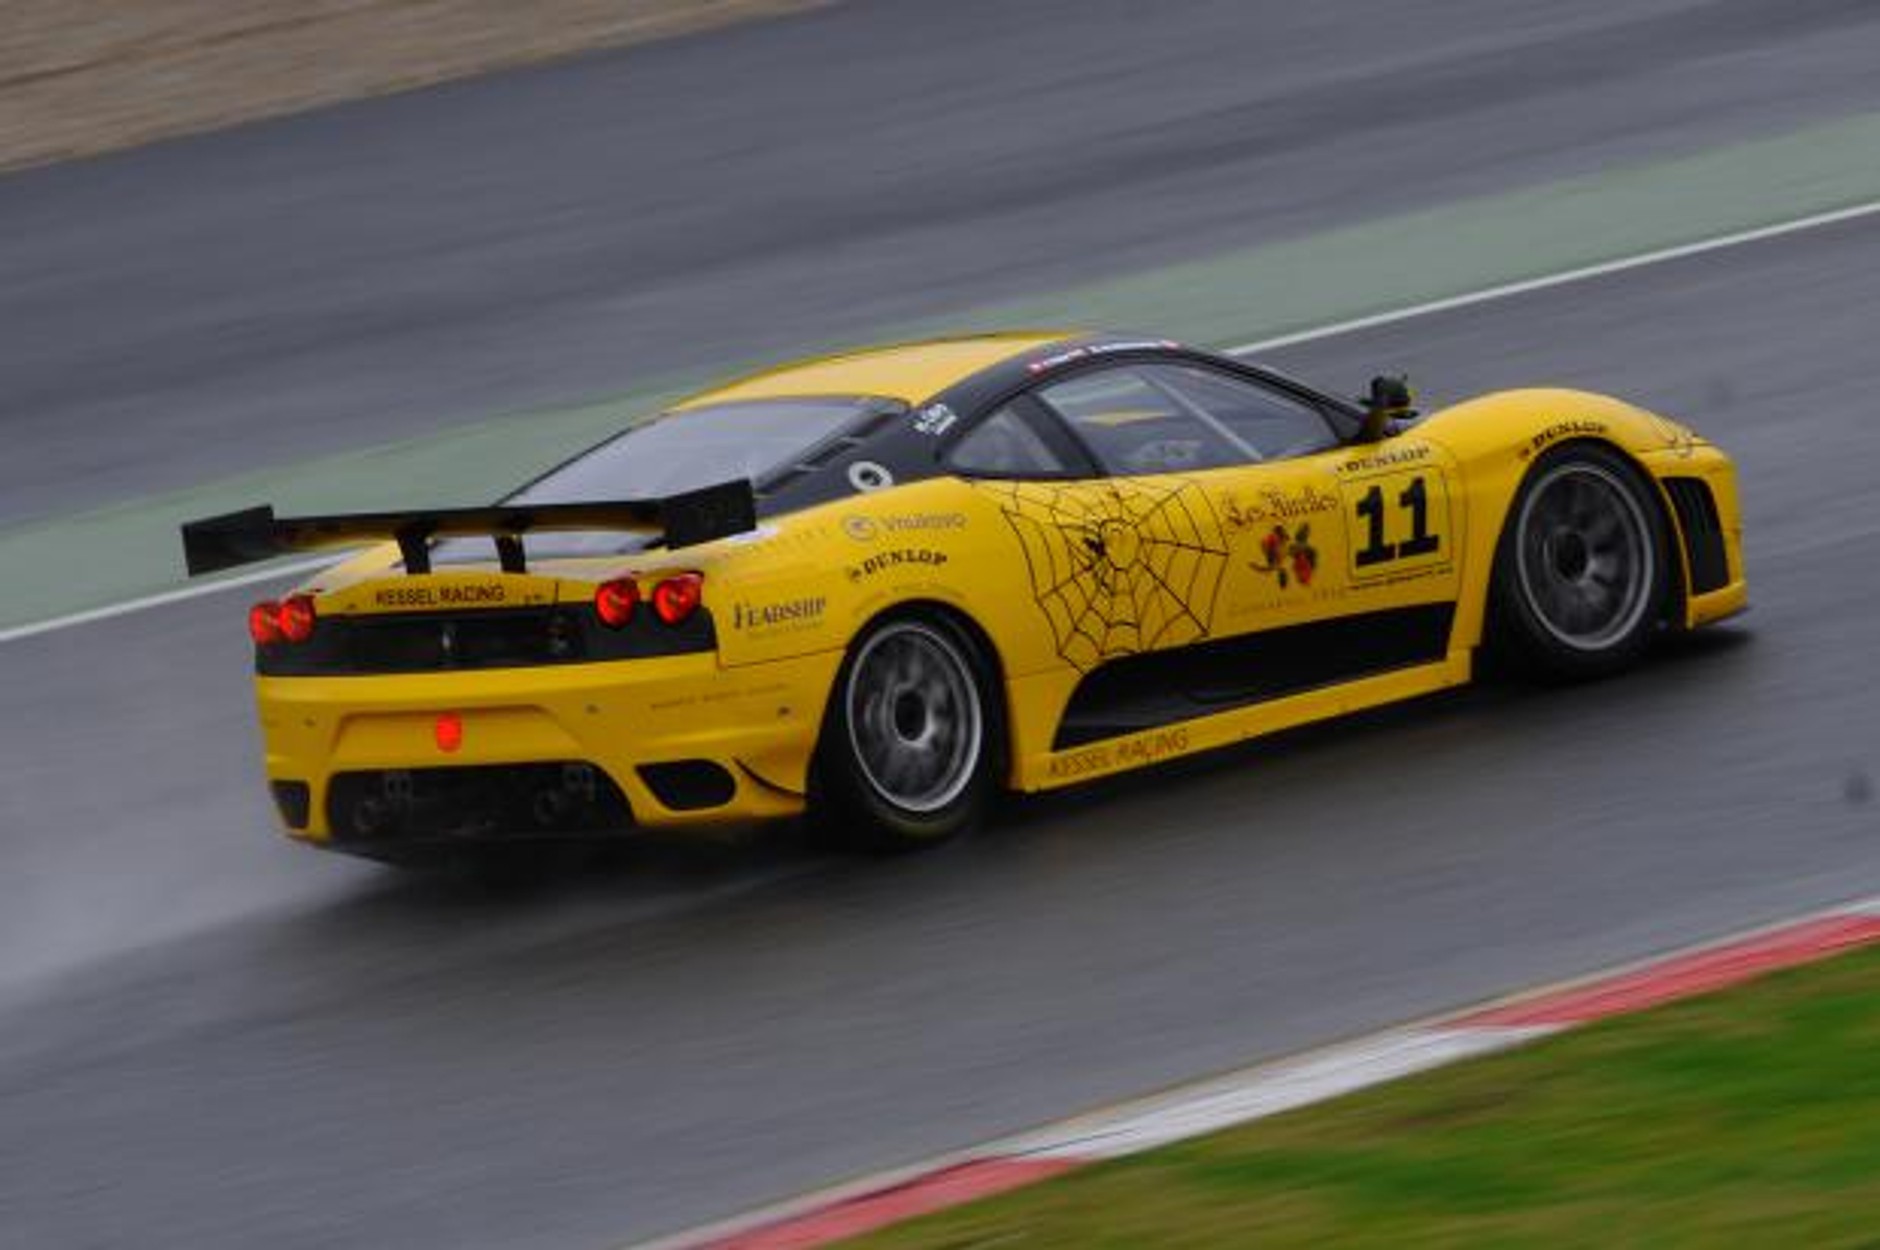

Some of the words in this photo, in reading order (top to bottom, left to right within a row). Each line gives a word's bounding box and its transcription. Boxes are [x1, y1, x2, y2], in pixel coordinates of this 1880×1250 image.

[1532, 421, 1608, 447] DUNLOP
[1346, 447, 1430, 471] DUNLOP
[1355, 476, 1440, 568] 11
[863, 549, 948, 574] DUNLOP
[376, 587, 438, 606] KESSEL
[439, 584, 505, 602] RACING
